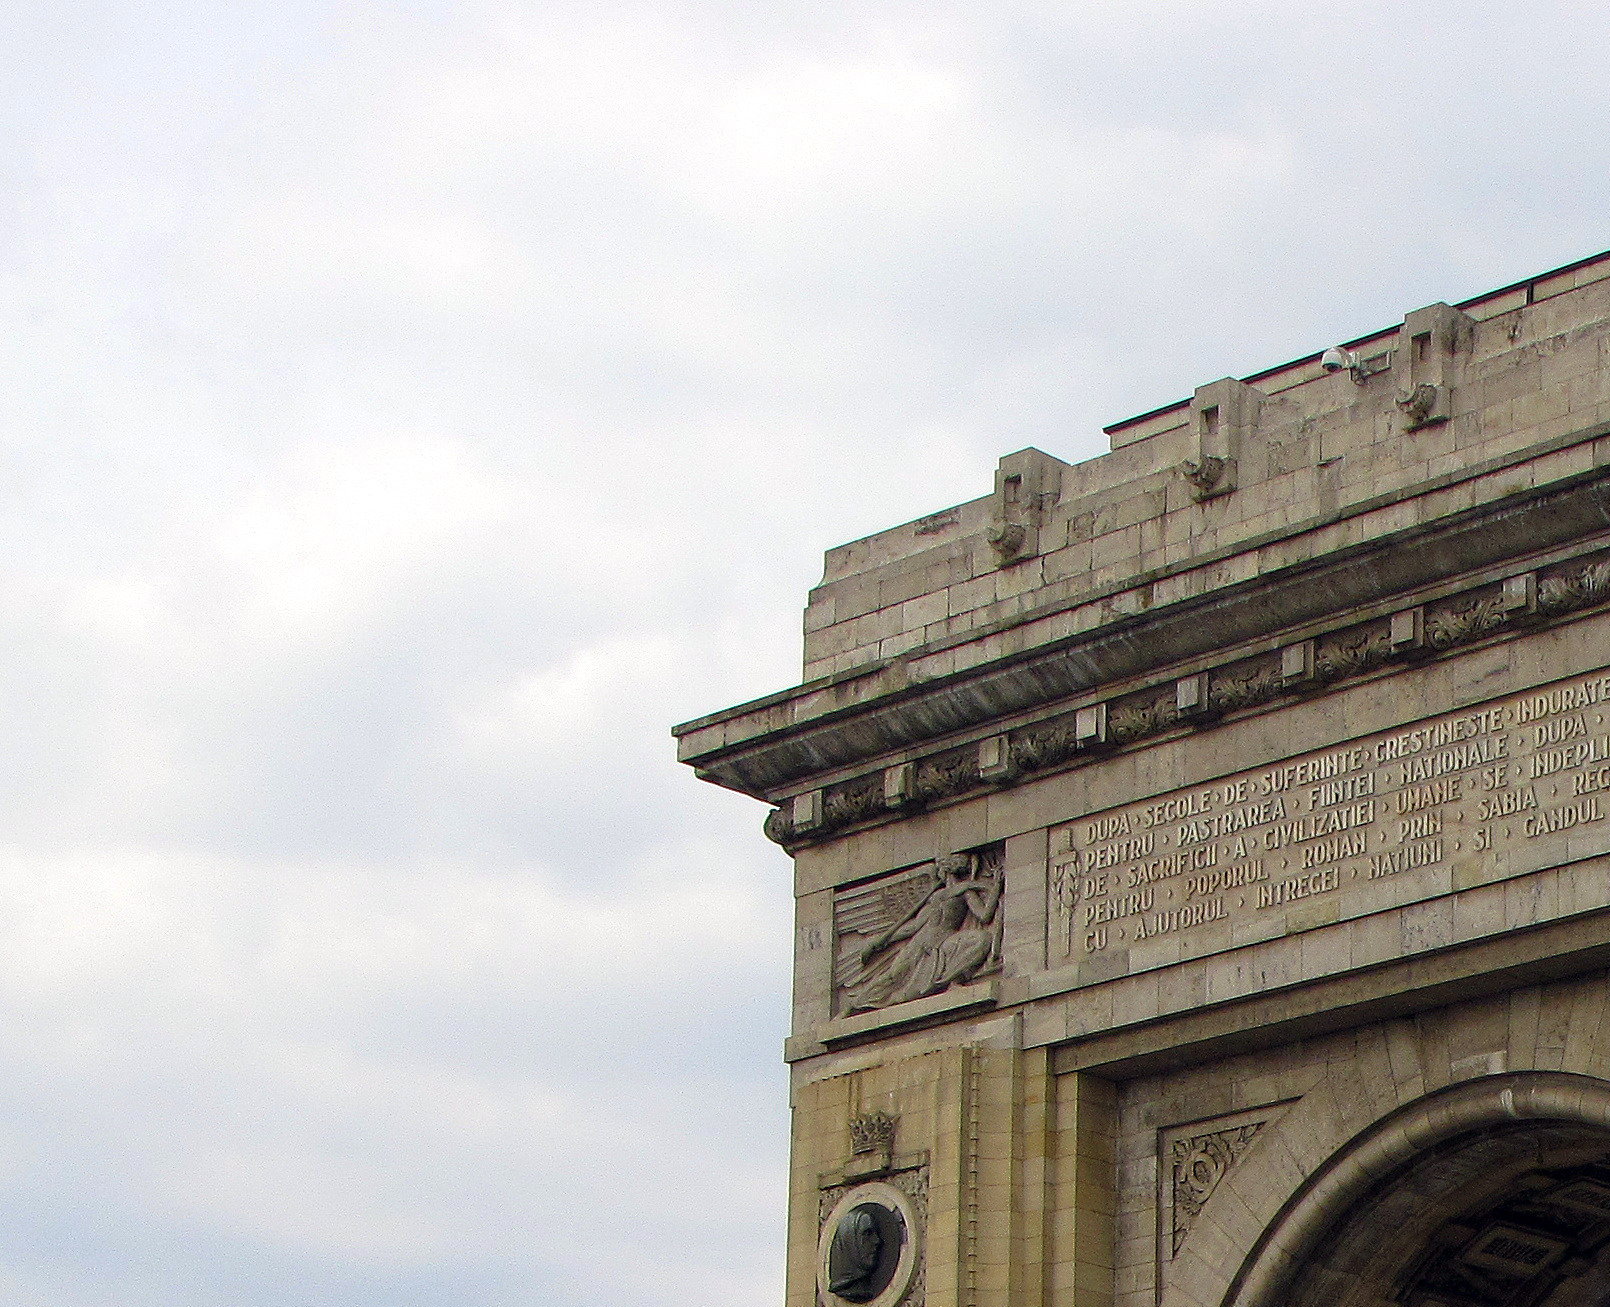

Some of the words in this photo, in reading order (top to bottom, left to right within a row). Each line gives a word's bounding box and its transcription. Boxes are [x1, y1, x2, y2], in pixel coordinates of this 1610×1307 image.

[1084, 813, 1132, 846] DUPA
[1144, 790, 1212, 829] SECOLE
[1223, 779, 1248, 806] DE
[1261, 746, 1364, 796] SUFERINTE
[1375, 707, 1504, 763] CRESTINESTE
[1084, 832, 1155, 873] PENTRU
[1177, 797, 1286, 848] PASTRAREA
[1308, 772, 1375, 811] FIINTEI
[1400, 734, 1508, 785] NATIONALE
[1534, 713, 1587, 748] DUPA
[1084, 875, 1108, 900] DE
[1128, 842, 1218, 888] SACRIFICII
[1232, 836, 1247, 860] A
[1263, 800, 1375, 851] CIVILIZATIEI
[1396, 777, 1462, 815] UMANE
[1481, 765, 1508, 791] SE
[1084, 888, 1154, 927] PENTRU
[1186, 860, 1269, 900] POPORUL
[1301, 830, 1366, 870] ROMAN
[1399, 809, 1442, 843] PRIN
[1477, 785, 1538, 822] SABIA
[1084, 926, 1108, 954] CU
[1134, 899, 1228, 941] AJUTORUL
[1256, 867, 1340, 910] INTREGEI
[1368, 838, 1443, 880] NATIUNI
[1474, 825, 1493, 851] SI
[1524, 796, 1605, 838] GANDUL
